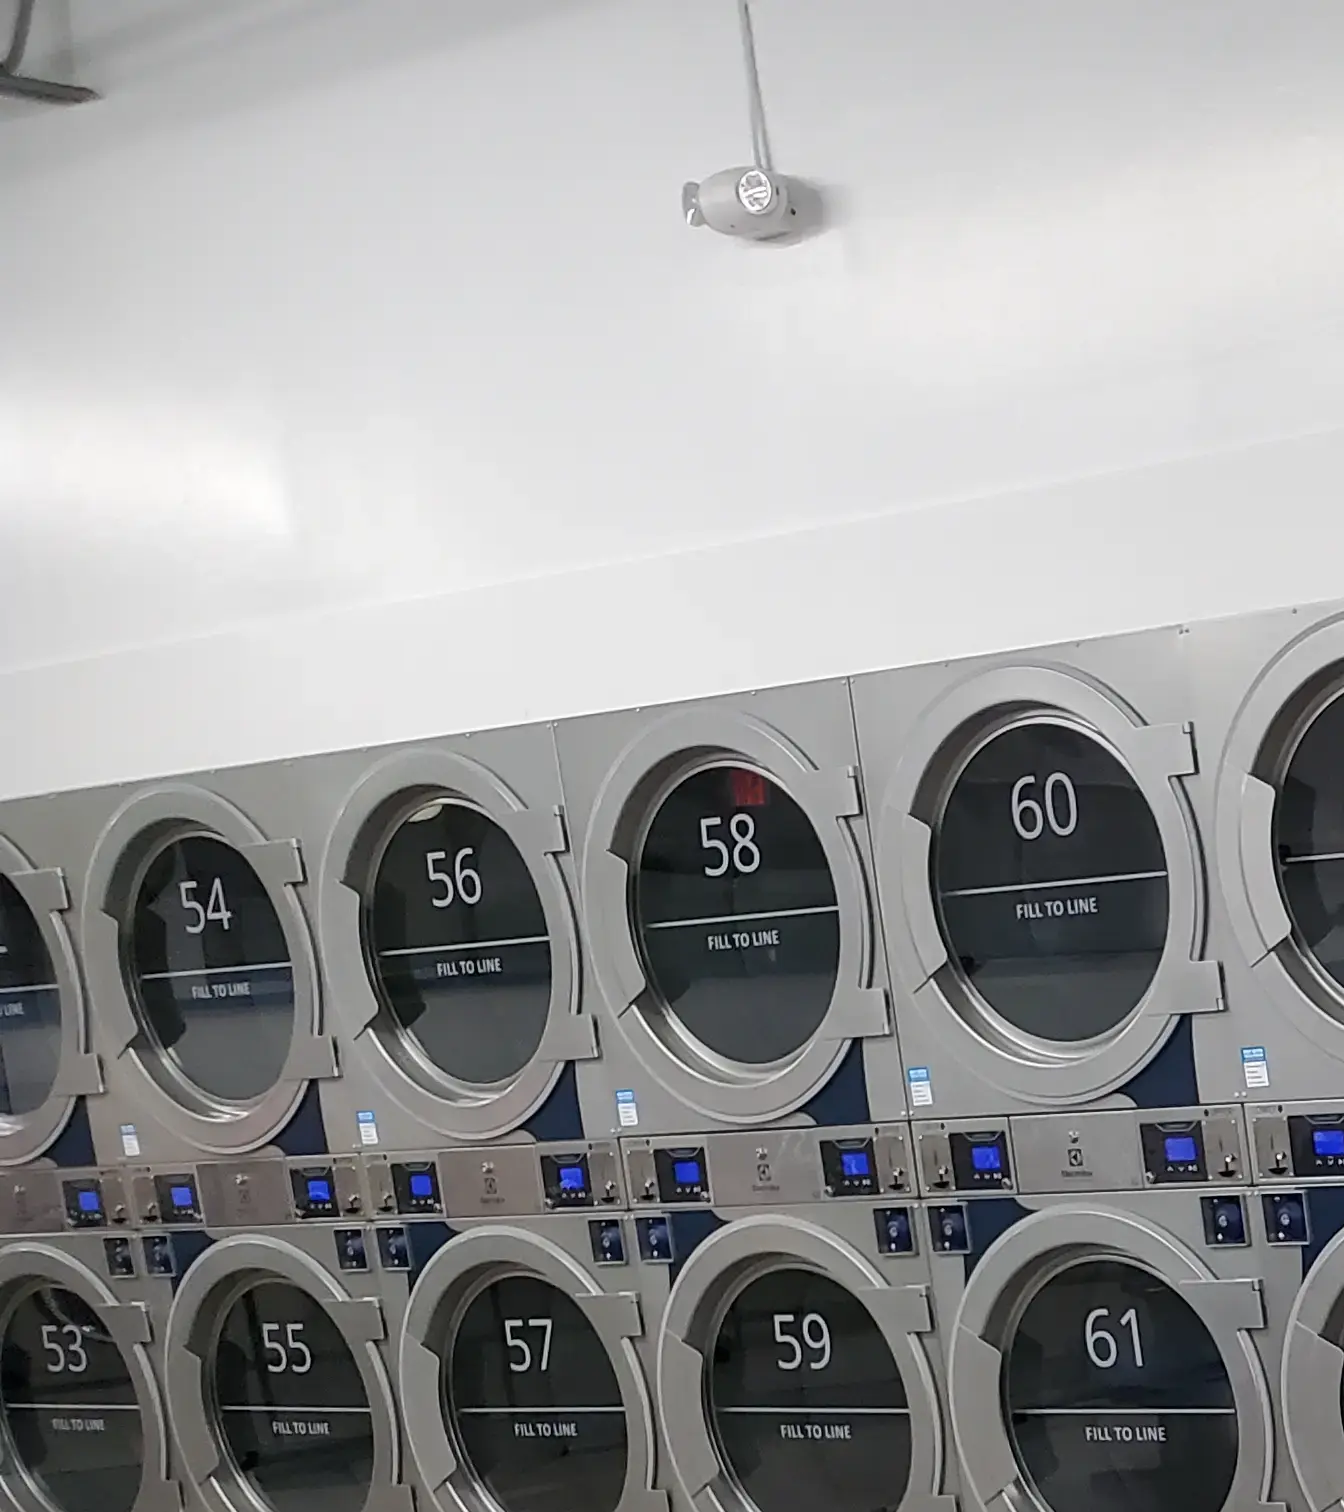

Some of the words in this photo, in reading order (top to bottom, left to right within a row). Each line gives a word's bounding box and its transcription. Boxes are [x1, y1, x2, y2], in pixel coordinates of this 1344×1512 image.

[1011, 772, 1077, 840] 60
[700, 813, 760, 877] 58
[426, 847, 482, 908] 56
[179, 877, 232, 934] 54
[1016, 902, 1043, 919] FILL
[1044, 900, 1064, 917] TO
[1066, 897, 1098, 915] LINE
[707, 934, 732, 950] FILL
[732, 932, 750, 948] TO
[752, 930, 780, 946] LINE
[212, 984, 227, 998] TO
[437, 962, 459, 977] FILL
[459, 960, 475, 975] TO
[477, 958, 502, 973] LINE
[41, 1324, 87, 1372] 53
[262, 1323, 311, 1373] 55
[504, 1318, 552, 1372] 57
[773, 1313, 831, 1370] 59
[1085, 1308, 1143, 1368] 61
[292, 1421, 306, 1435] TO
[514, 1423, 536, 1437] FILL
[536, 1422, 551, 1437] TO
[552, 1422, 578, 1437] LINE
[780, 1424, 804, 1439] FILL
[804, 1424, 822, 1440] TO
[824, 1424, 851, 1439] LINE
[1085, 1427, 1112, 1441] FILL
[1113, 1427, 1133, 1442] TO
[1135, 1427, 1167, 1441] LINE
